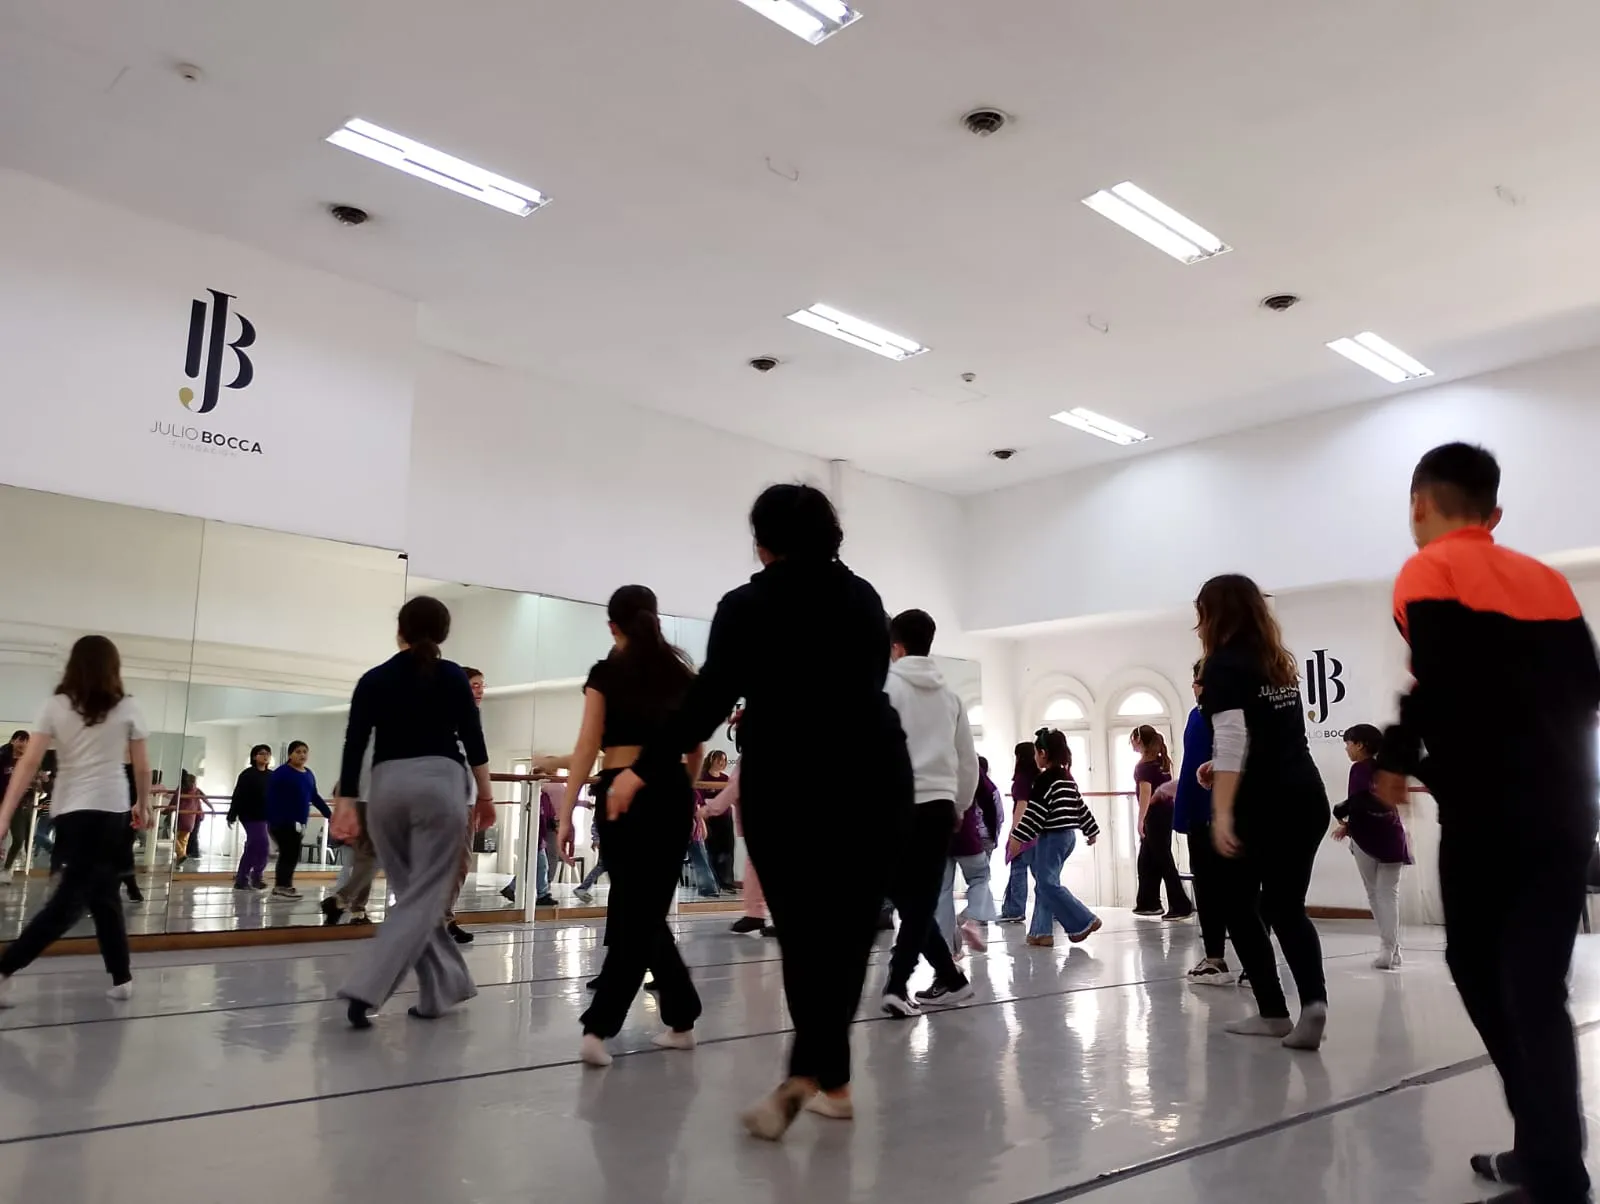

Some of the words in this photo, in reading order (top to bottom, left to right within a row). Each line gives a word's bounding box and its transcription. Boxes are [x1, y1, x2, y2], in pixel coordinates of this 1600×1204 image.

[150, 421, 199, 440] JULIO
[201, 431, 263, 455] BOCCA
[1323, 730, 1344, 738] BOC
